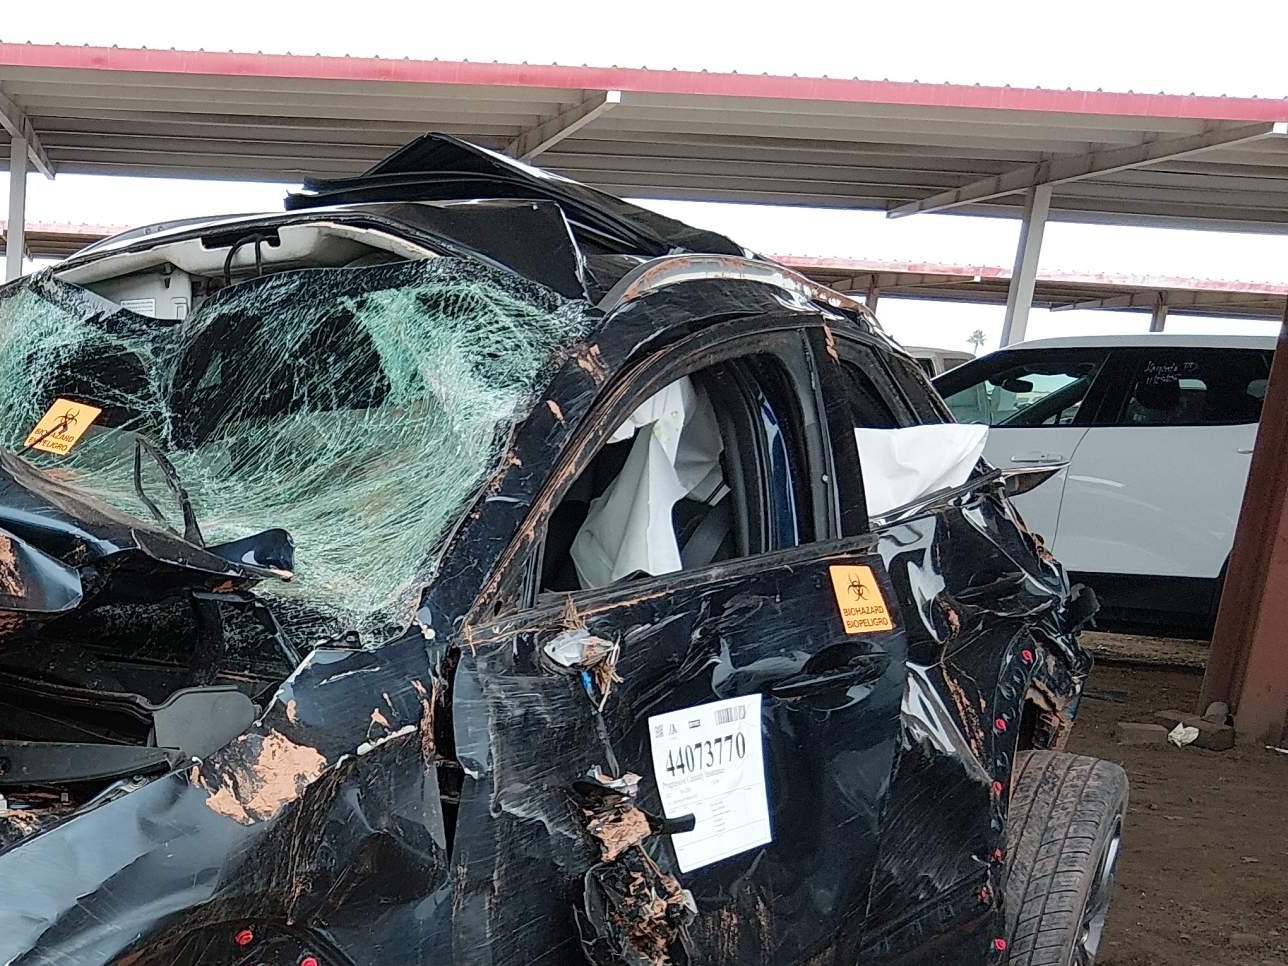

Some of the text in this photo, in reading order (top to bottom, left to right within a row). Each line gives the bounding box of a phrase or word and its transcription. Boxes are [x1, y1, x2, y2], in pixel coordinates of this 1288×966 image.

[843, 606, 884, 616] BIOHAZARD
[847, 618, 888, 628] BIOPELIGRO
[665, 731, 746, 777] 44073770
